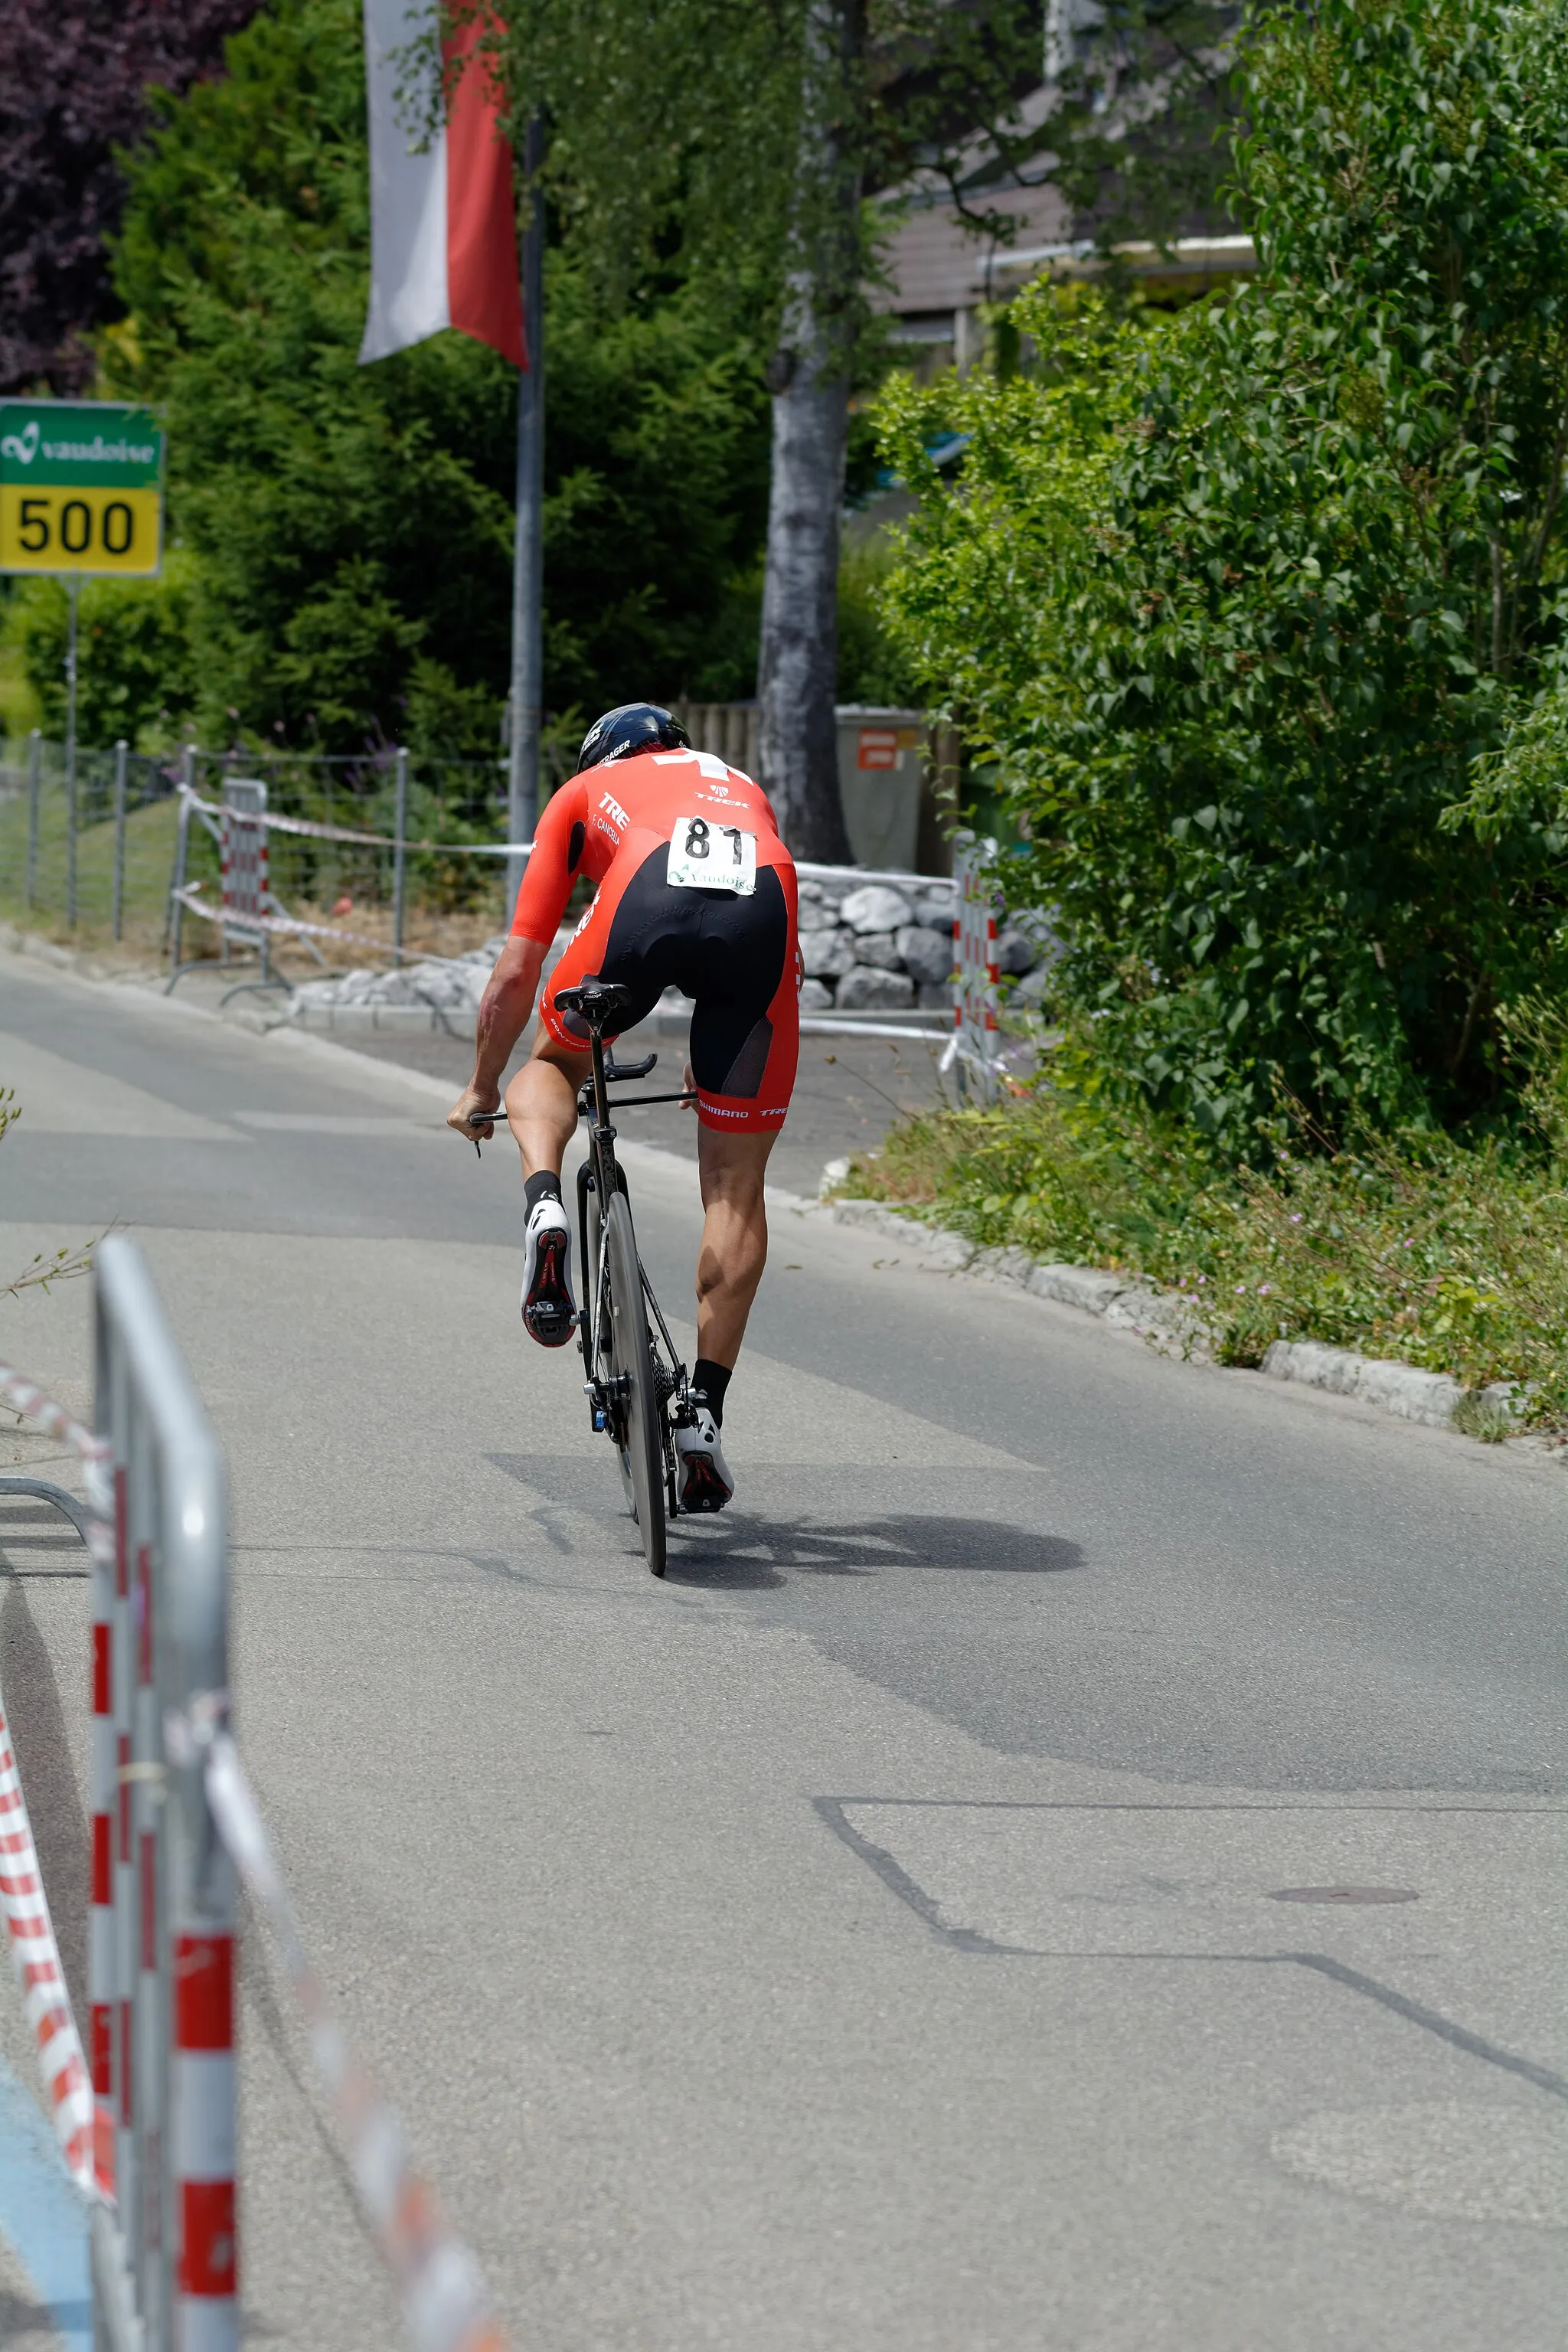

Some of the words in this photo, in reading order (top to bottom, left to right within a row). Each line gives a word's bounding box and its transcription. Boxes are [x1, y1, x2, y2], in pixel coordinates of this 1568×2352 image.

[20, 498, 135, 554] 500
[597, 740, 631, 765] TRAGER
[694, 792, 750, 809] TREK
[685, 817, 743, 866] 81
[699, 1099, 749, 1119] SHIMANO
